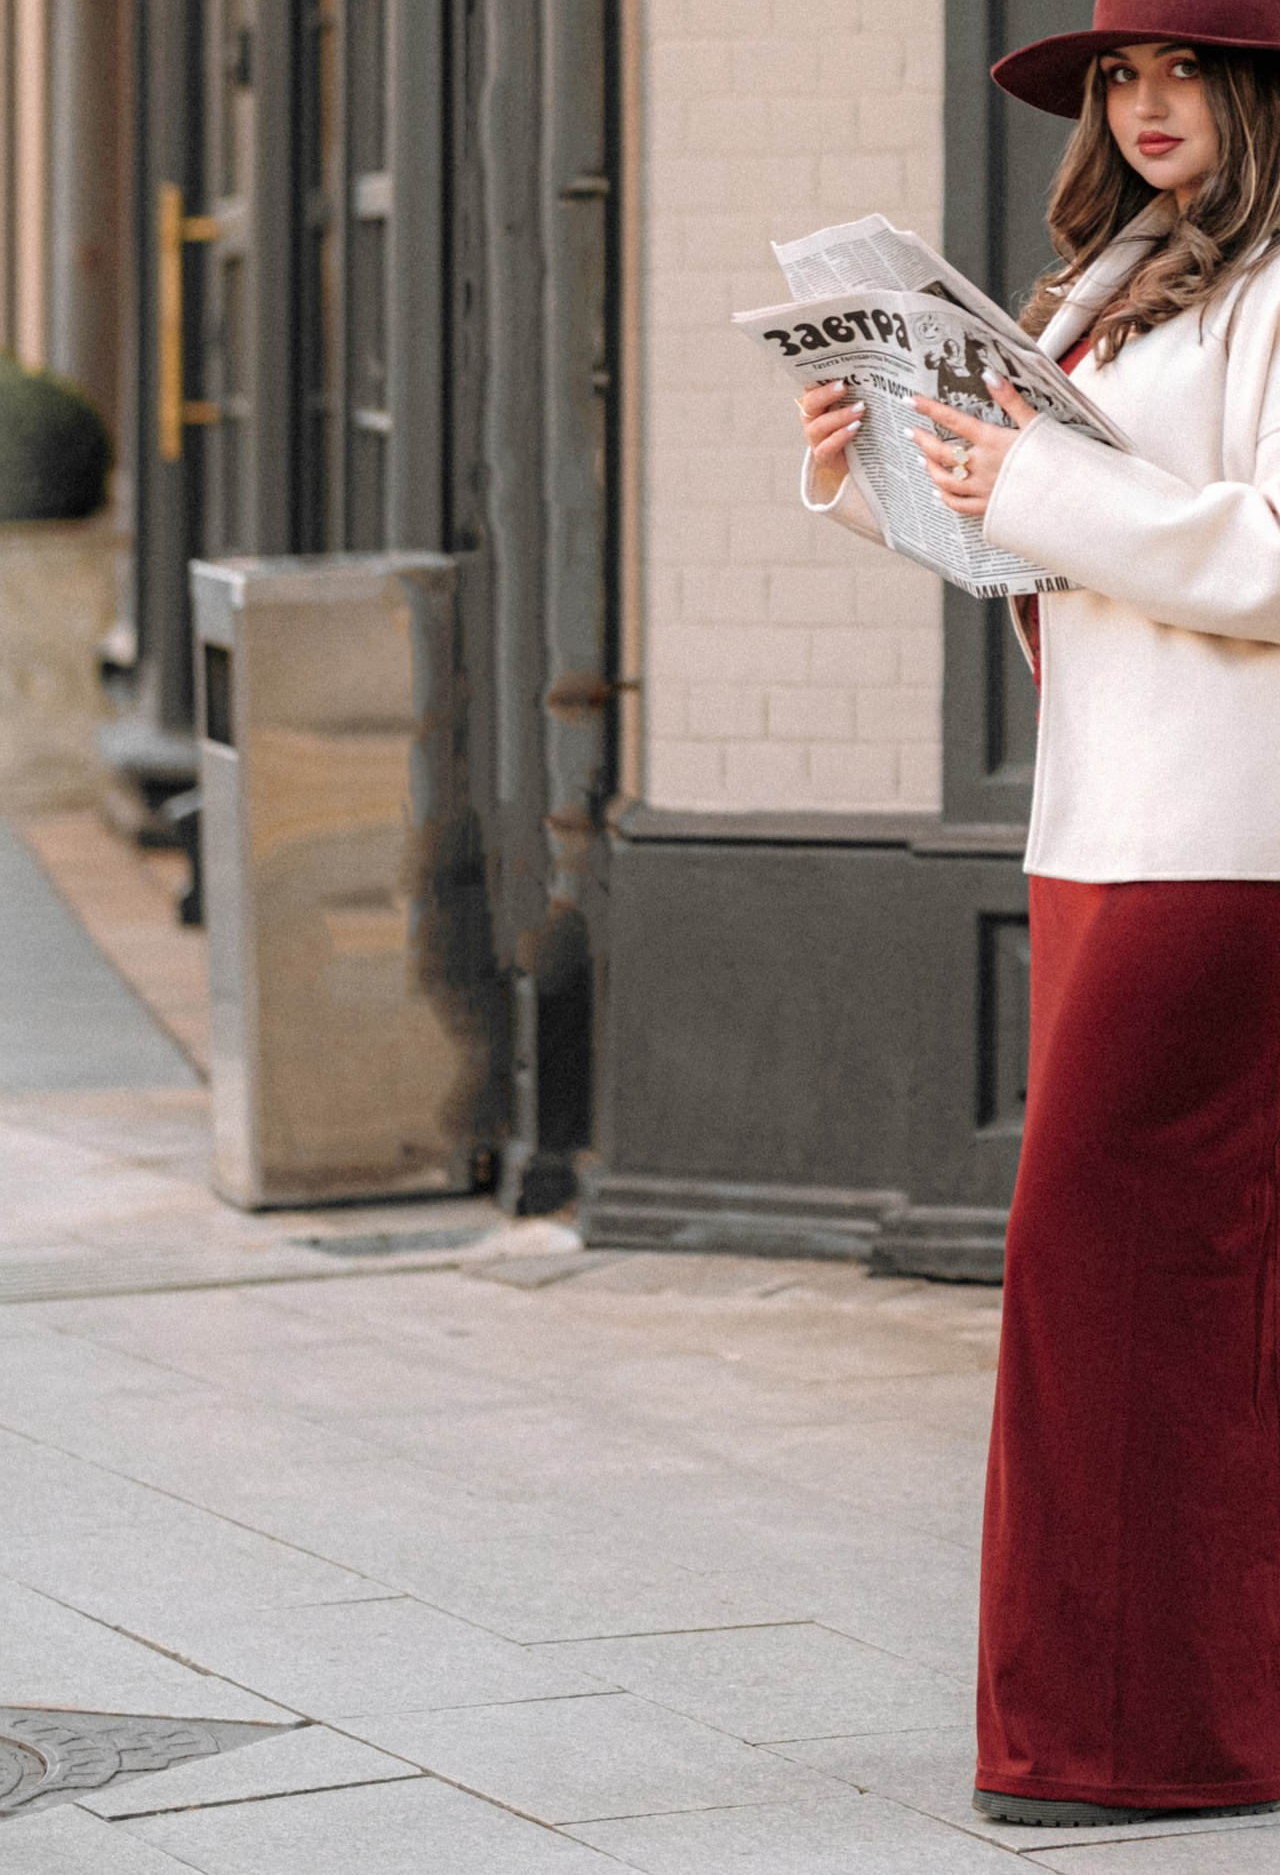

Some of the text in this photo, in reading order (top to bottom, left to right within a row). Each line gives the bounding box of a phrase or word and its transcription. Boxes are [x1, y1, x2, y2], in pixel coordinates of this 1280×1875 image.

[870, 373, 887, 392] ЭТО
[975, 582, 1008, 599] МИР
[1034, 576, 1070, 593] НАШ
